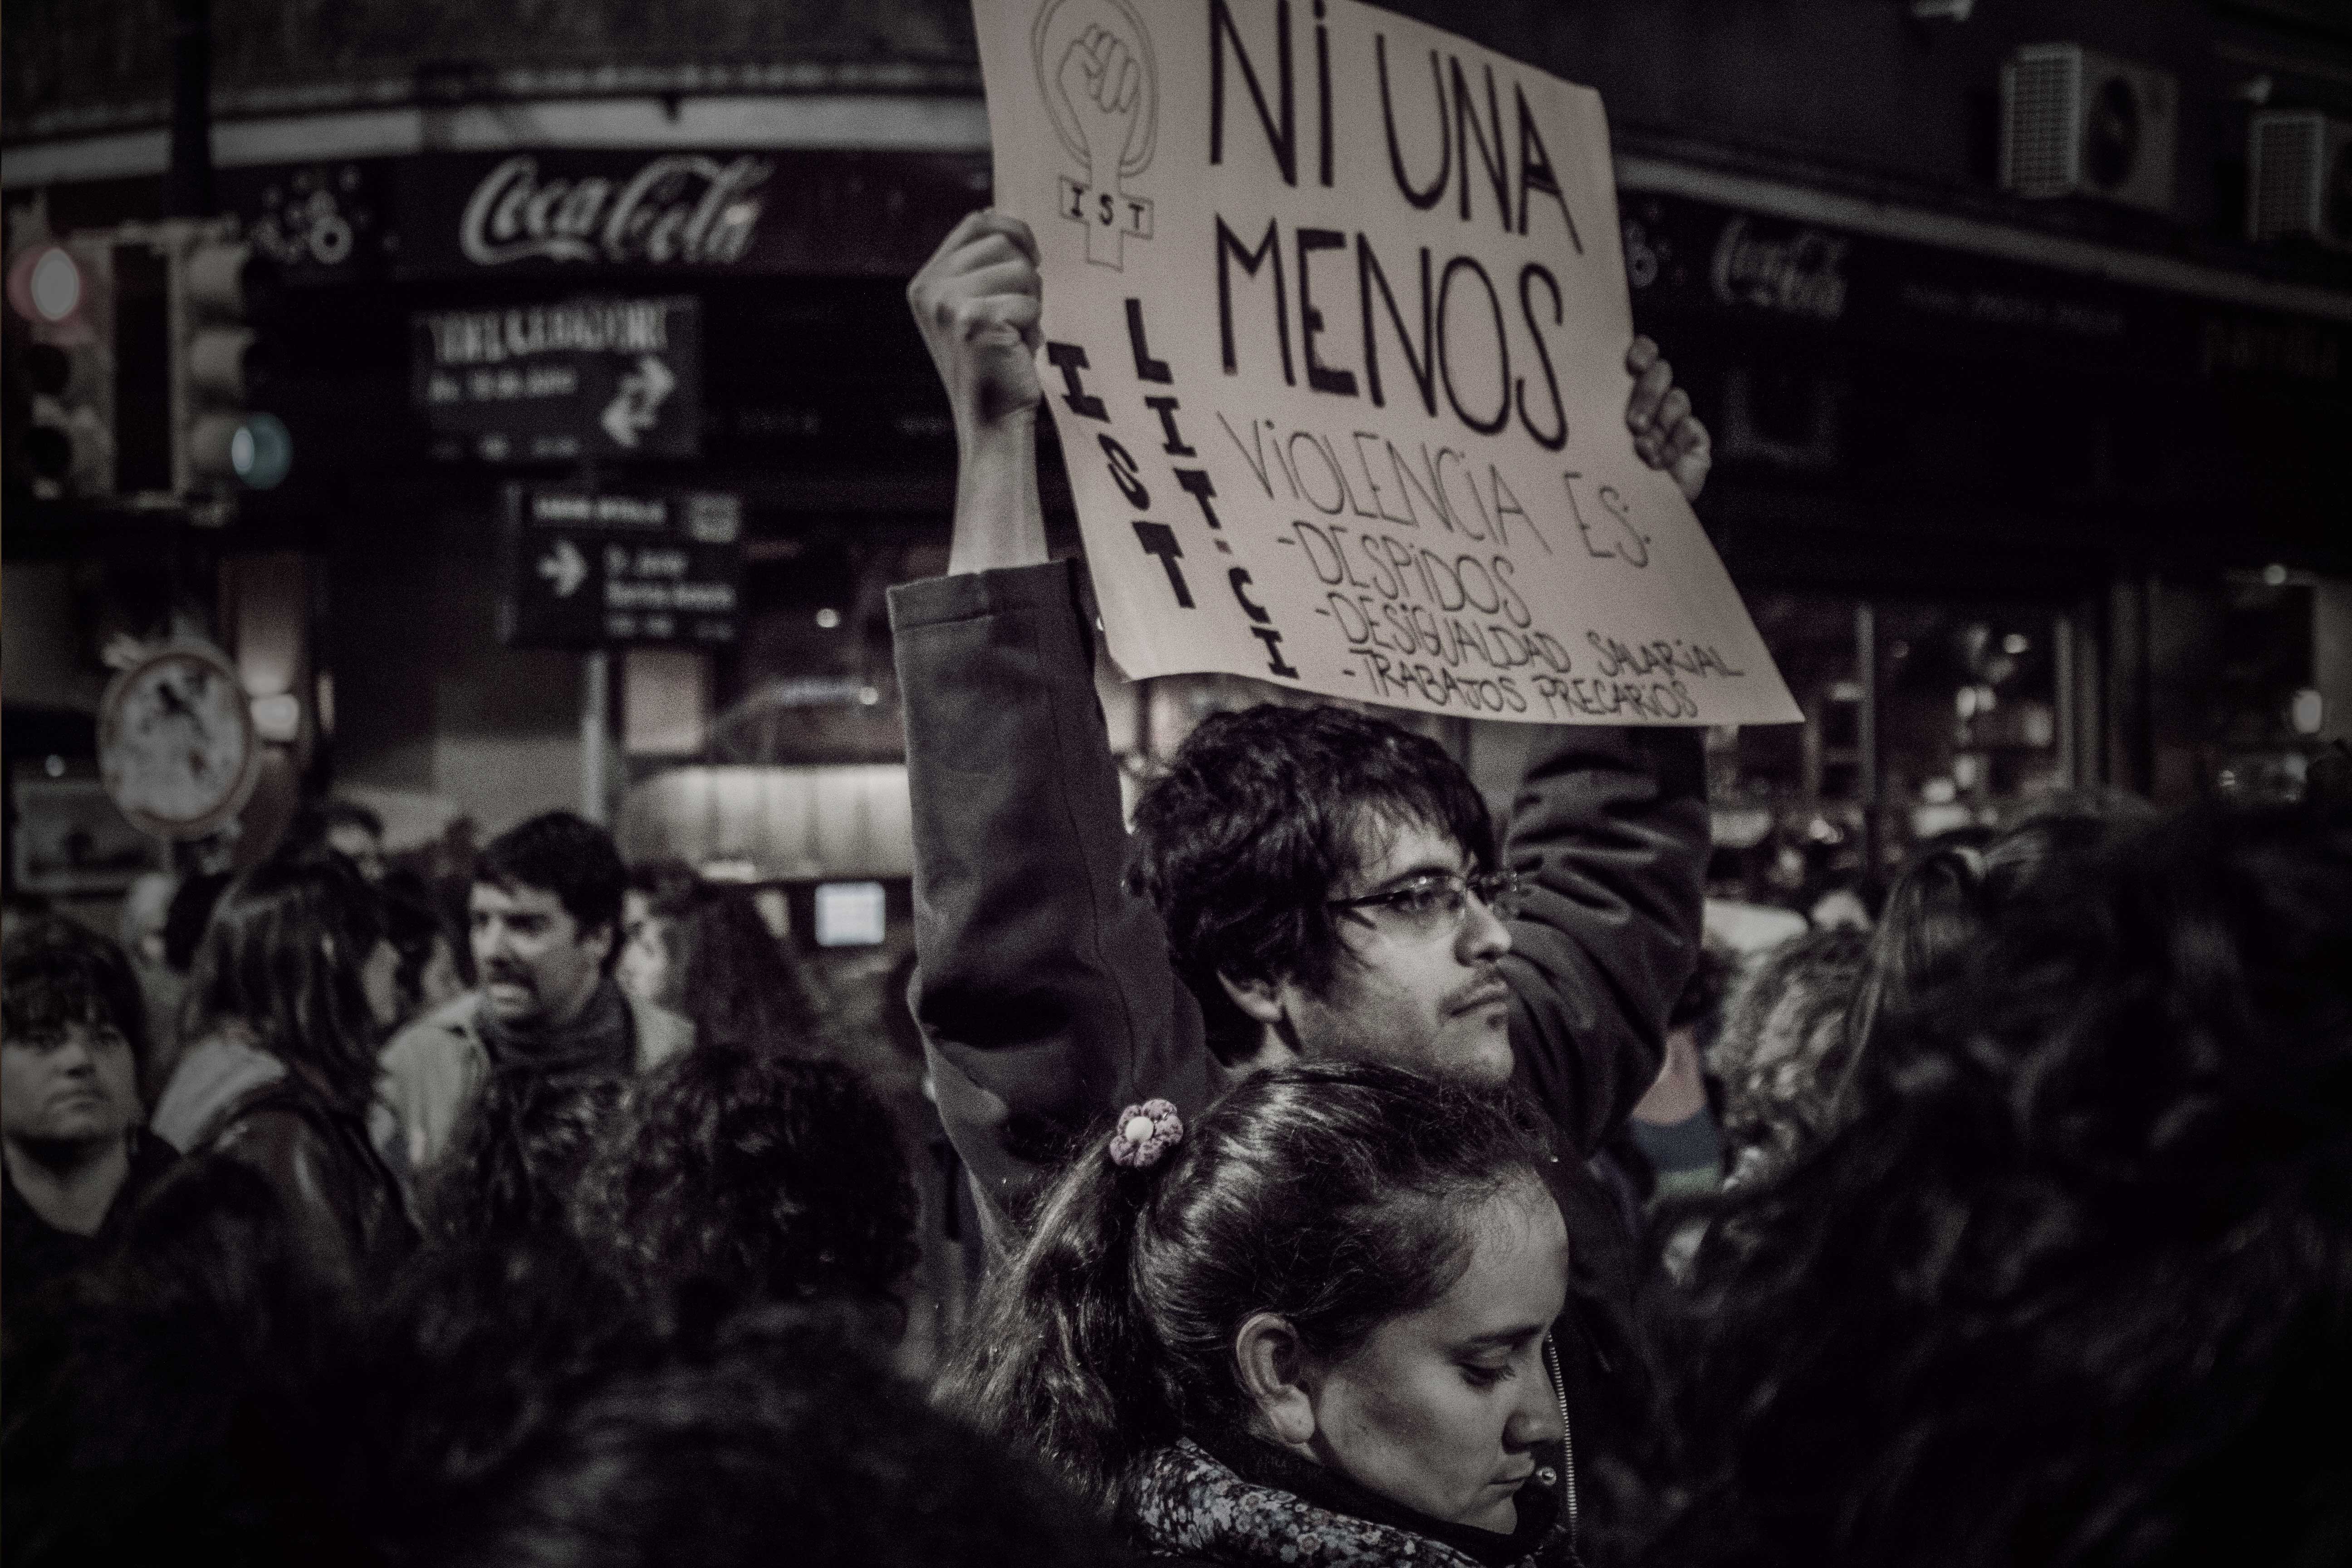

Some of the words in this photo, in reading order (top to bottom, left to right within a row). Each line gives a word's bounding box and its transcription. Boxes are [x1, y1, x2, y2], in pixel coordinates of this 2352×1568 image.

[1070, 185, 1144, 229] IST
[1376, 33, 1583, 255] UNA
[1216, 213, 1567, 450] MENOS
